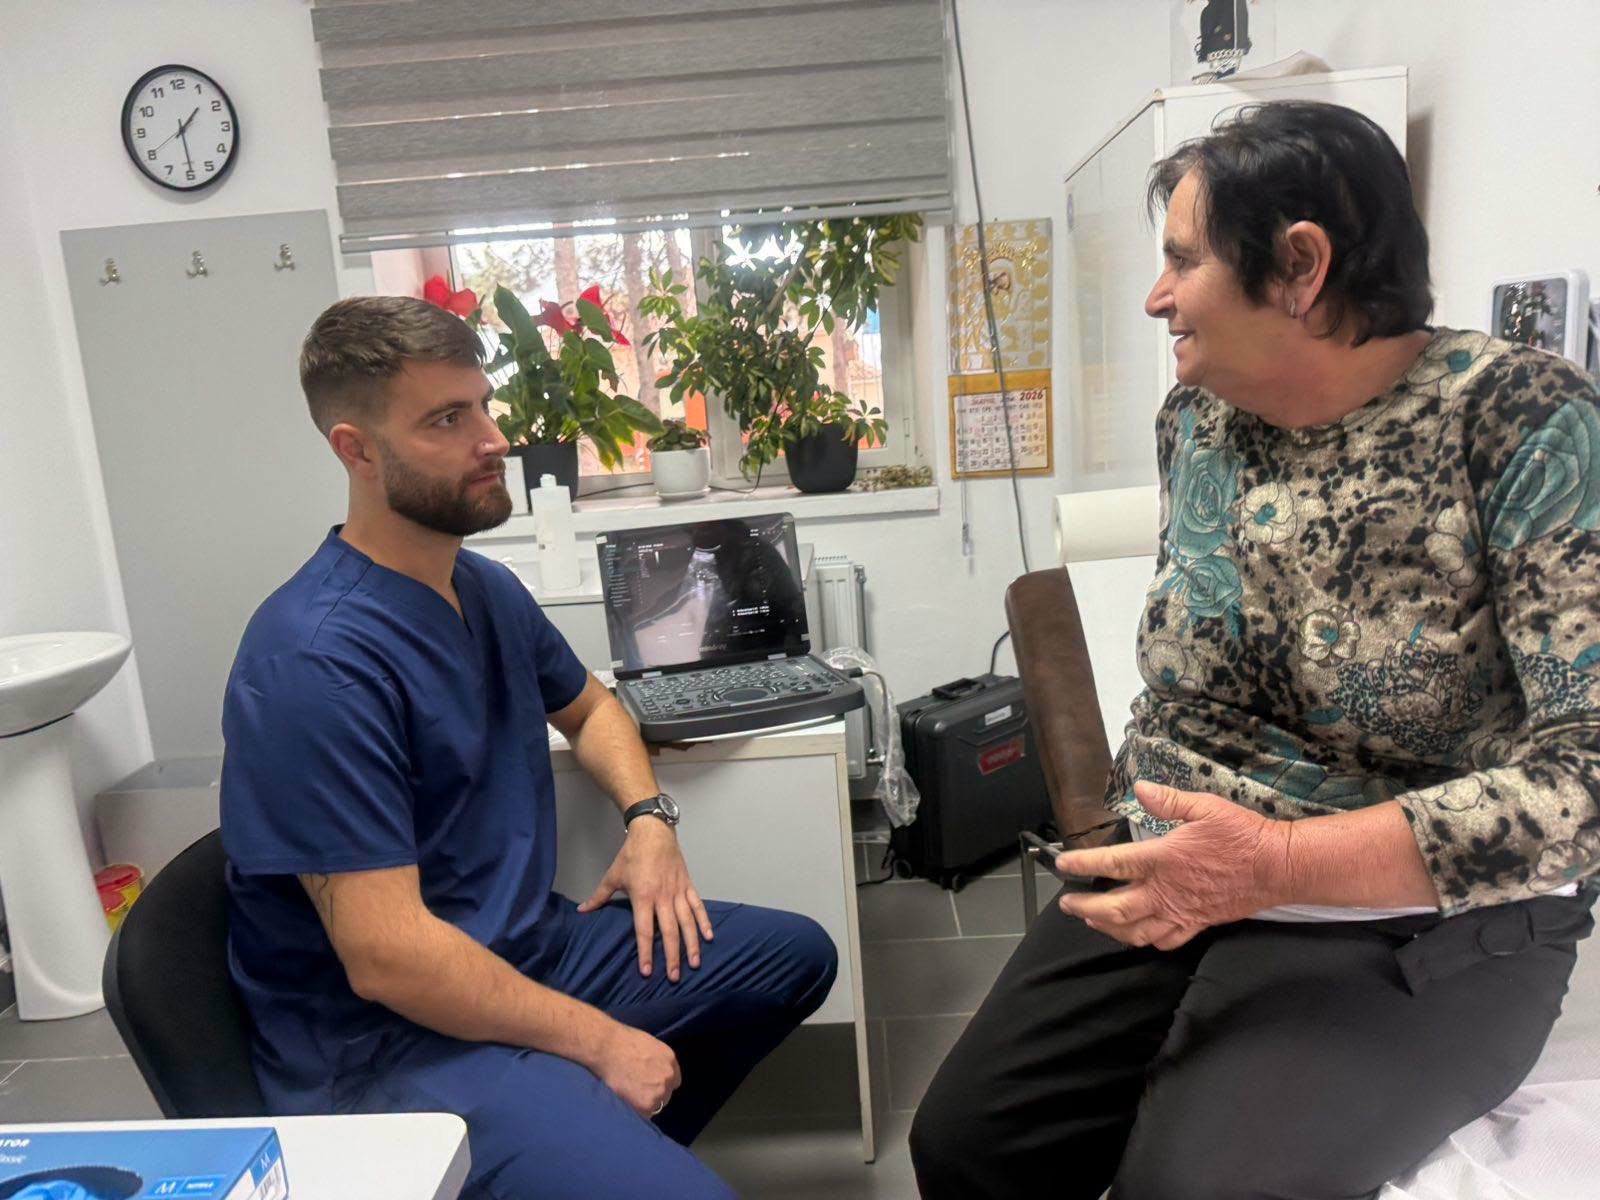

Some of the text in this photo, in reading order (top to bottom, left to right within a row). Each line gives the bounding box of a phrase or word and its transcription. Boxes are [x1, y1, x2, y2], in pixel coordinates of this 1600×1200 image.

[170, 78, 185, 91] 12
[194, 83, 202, 95] 1
[151, 87, 165, 98] 11
[139, 105, 154, 117] 10
[210, 100, 221, 111] 2
[220, 121, 231, 132] 3
[136, 127, 146, 138] 9
[216, 142, 227, 154] 4
[147, 149, 157, 160] 8
[164, 164, 174, 175] 7
[203, 160, 214, 172] 5
[185, 170, 195, 180] 6
[1020, 391, 1043, 401] 2026
[155, 1181, 177, 1194] M
